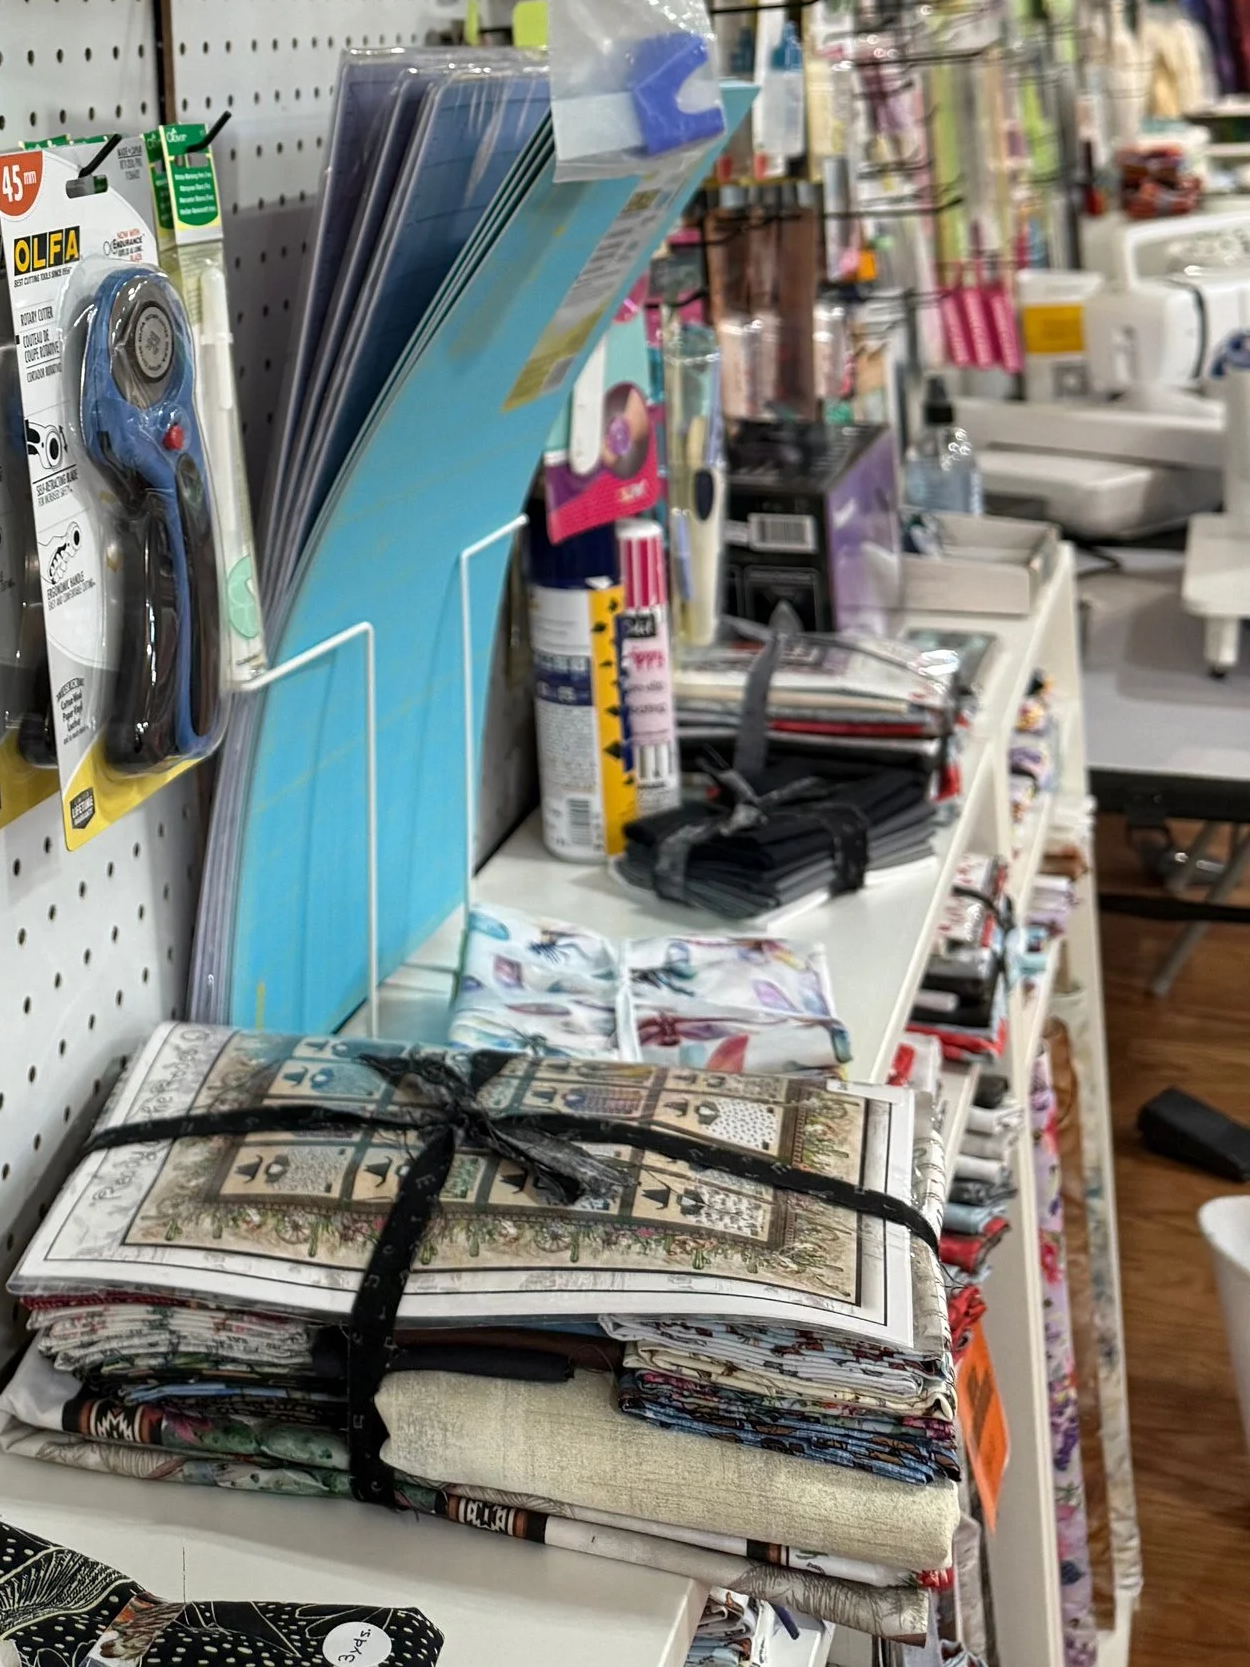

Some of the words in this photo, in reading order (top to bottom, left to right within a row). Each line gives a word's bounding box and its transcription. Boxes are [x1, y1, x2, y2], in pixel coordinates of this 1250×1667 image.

[2, 164, 23, 203] 45
[23, 170, 37, 184] mm
[14, 227, 79, 274] OLFA
